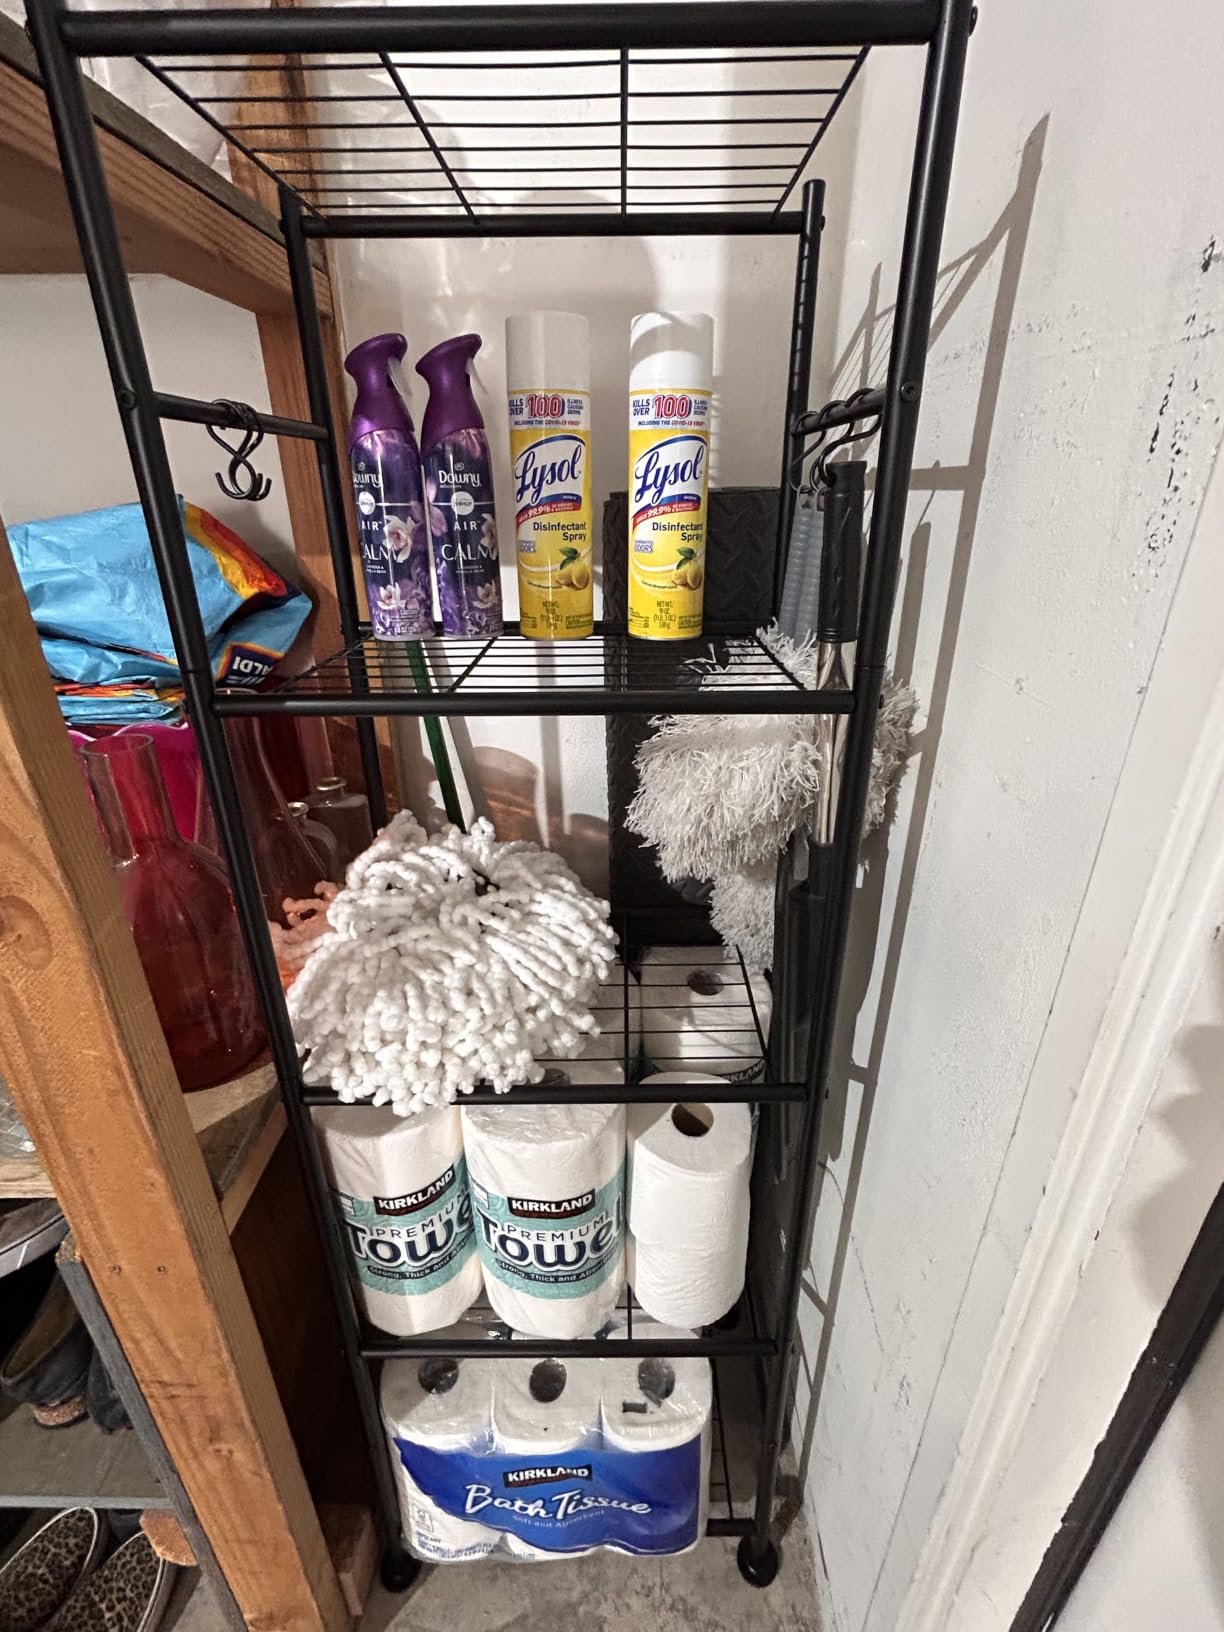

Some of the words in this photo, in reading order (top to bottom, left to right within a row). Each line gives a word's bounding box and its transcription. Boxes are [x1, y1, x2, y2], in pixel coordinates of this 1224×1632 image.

[527, 394, 565, 419] 100
[633, 399, 650, 407] KILLS
[633, 407, 650, 416] OVER
[653, 394, 691, 419] 100
[438, 470, 481, 487] Downy
[515, 444, 582, 504] Lysol
[635, 445, 704, 504] Lysol
[647, 504, 671, 518] 99.9%
[533, 522, 586, 531] Disinfectant
[652, 522, 703, 531] Disinfectant
[562, 532, 586, 542] Spray
[681, 532, 703, 542] Spray
[361, 543, 397, 560] ALM
[441, 544, 497, 560] CALM
[657, 600, 665, 608] NET
[232, 656, 273, 676] ALDI
[377, 1168, 454, 1210] KIRKLAND
[511, 1194, 593, 1212] KIRKLAND
[343, 1188, 472, 1264] Towe
[476, 1193, 623, 1267] Towel
[507, 1210, 609, 1242] PREMIUM
[405, 1267, 430, 1278] Thick
[433, 1255, 450, 1270] and
[530, 1273, 556, 1282] Thick
[558, 1274, 577, 1282] and
[508, 1467, 589, 1482] KIRKLAND
[465, 1484, 553, 1518] Bath
[551, 1488, 652, 1520] Tissue
